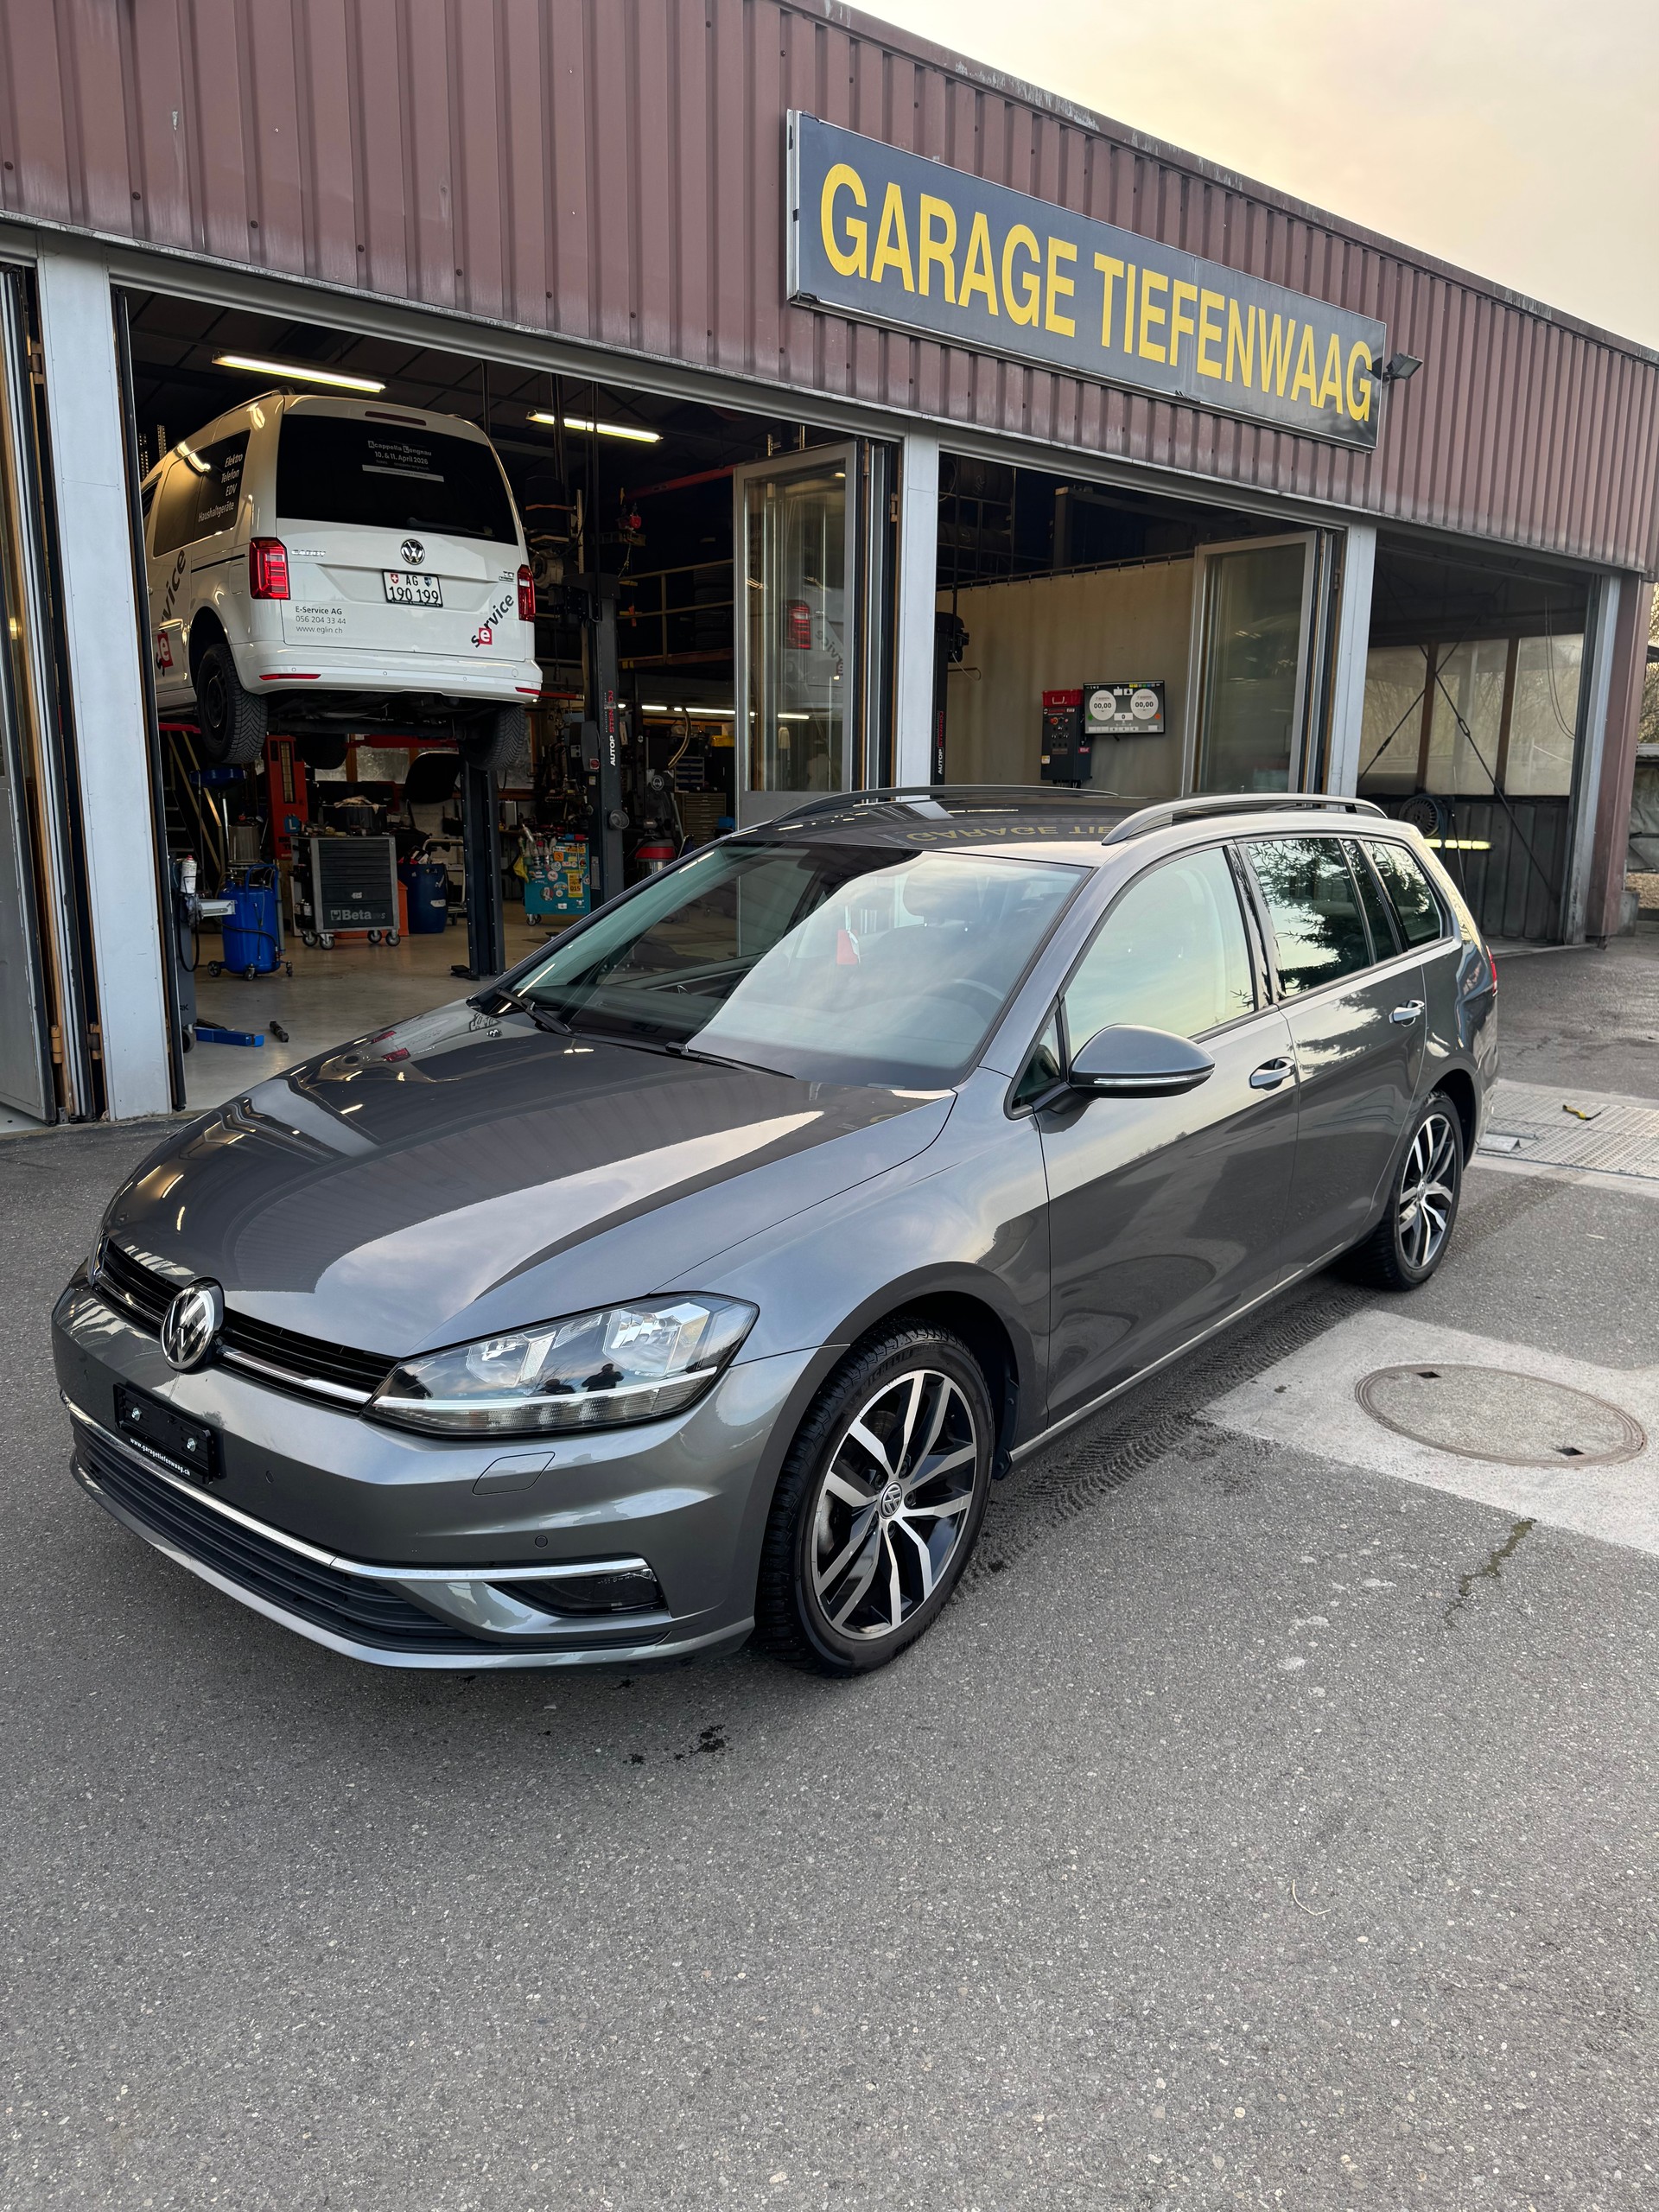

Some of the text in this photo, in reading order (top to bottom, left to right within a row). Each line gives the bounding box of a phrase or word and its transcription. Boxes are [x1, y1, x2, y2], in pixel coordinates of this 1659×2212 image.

[819, 162, 1373, 423] GARAGE TIEFENWAAG
[367, 440, 402, 451] Acappella
[225, 454, 243, 467] Elektro
[398, 454, 413, 463] April
[414, 456, 429, 465] 2026
[220, 468, 240, 484] Telefon
[226, 483, 238, 497] EDV
[198, 501, 234, 523] Haushaltgeräte
[405, 575, 419, 587] AG
[389, 586, 413, 601] 190
[416, 588, 439, 604] 199
[295, 606, 329, 615] E-Service
[471, 594, 514, 648] service
[296, 625, 343, 635] www.eglin.ch
[289, 818, 296, 830] L
[341, 909, 372, 920] Beta
[130, 1437, 191, 1477] www.garagetiefenwaag.ch
